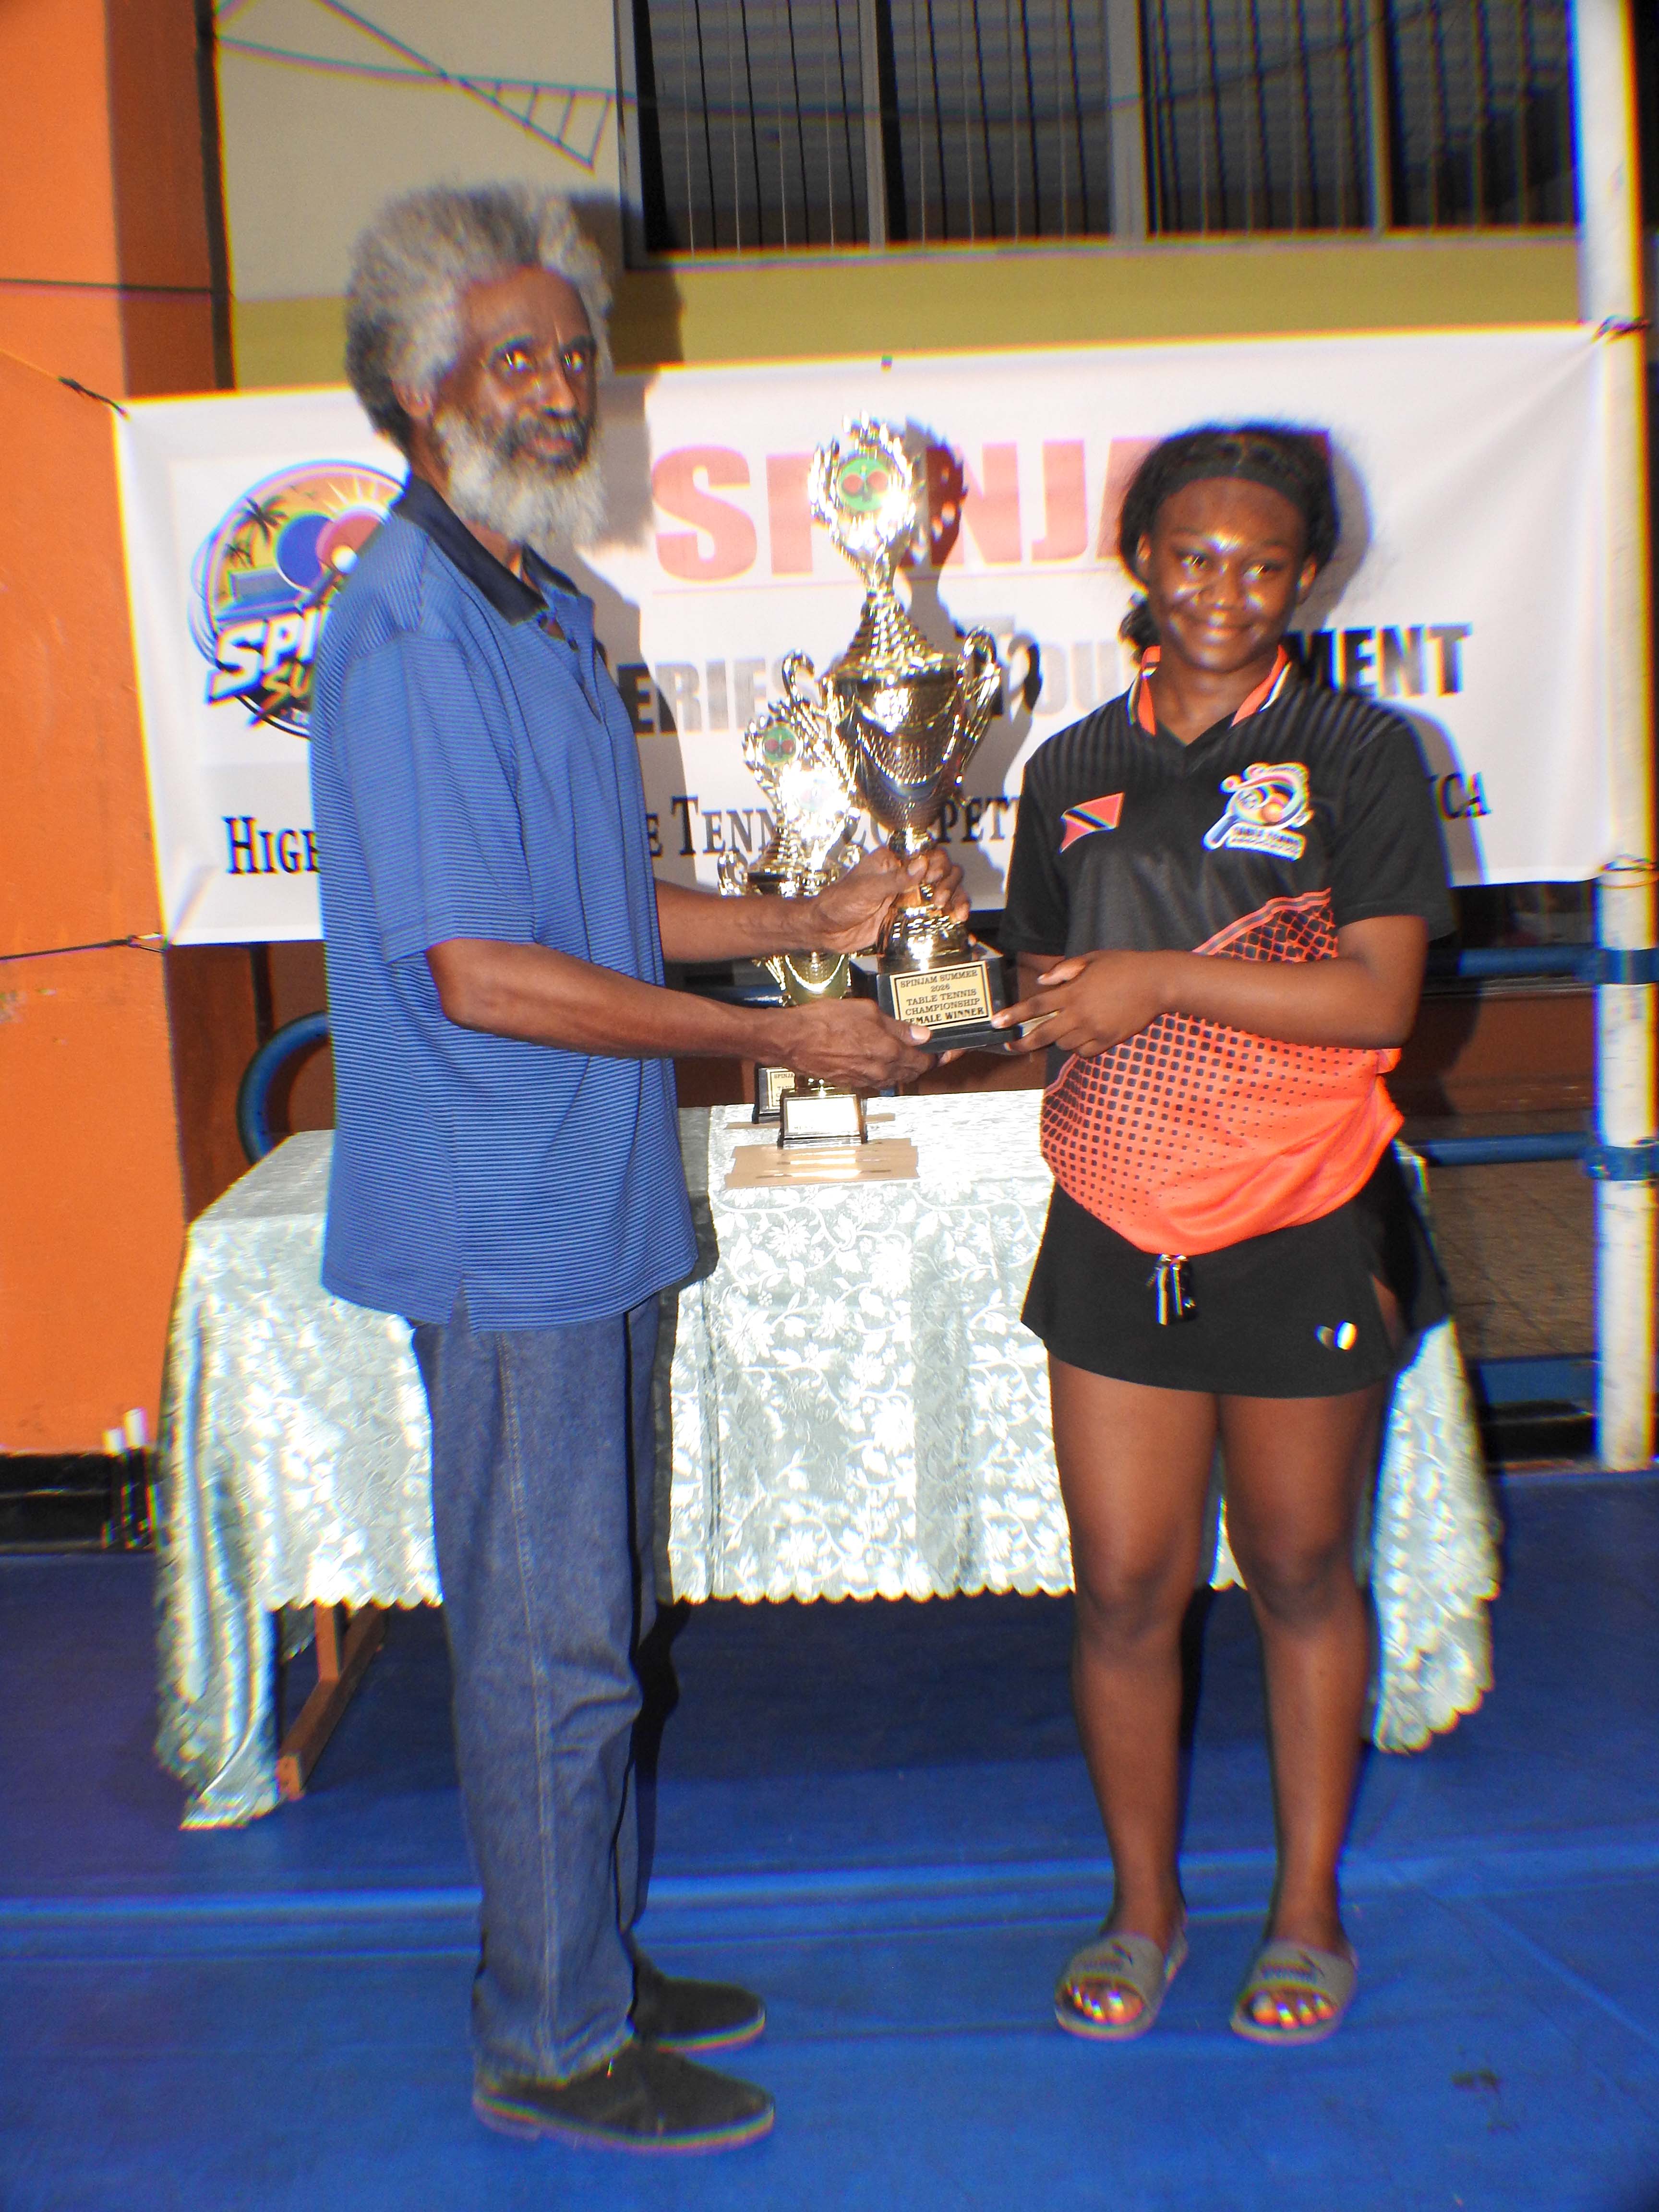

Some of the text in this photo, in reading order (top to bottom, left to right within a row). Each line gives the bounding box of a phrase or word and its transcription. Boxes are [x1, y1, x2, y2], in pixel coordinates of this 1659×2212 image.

[671, 794, 779, 855] TENN
[901, 970, 978, 988] SPINJAM SUMMER
[906, 989, 977, 1006] TABLE TENNIS
[905, 998, 980, 1016] CHAMPIONSHIP
[945, 1007, 984, 1020] WINNER
